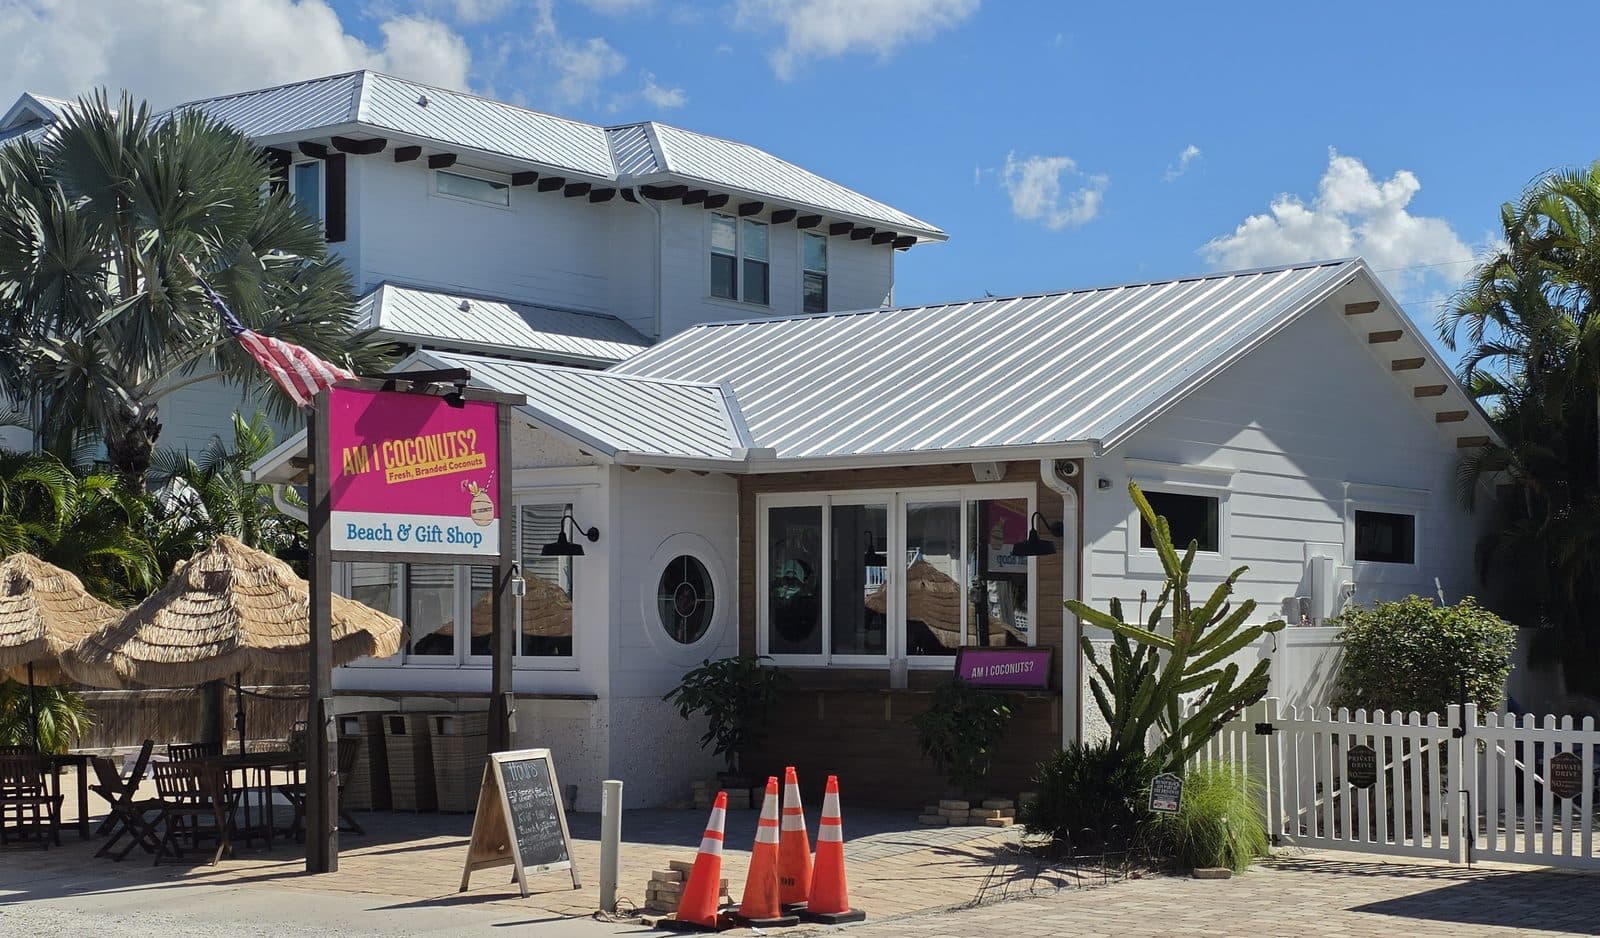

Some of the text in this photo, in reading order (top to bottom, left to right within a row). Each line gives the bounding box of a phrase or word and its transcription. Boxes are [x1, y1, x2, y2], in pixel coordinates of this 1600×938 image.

[343, 428, 477, 477] AM I COCONUTS?
[389, 457, 483, 481] Fresh, Branded Coconuts
[347, 523, 482, 548] Beach & Gift Shop
[971, 661, 1034, 678] AM I COCONUTS?
